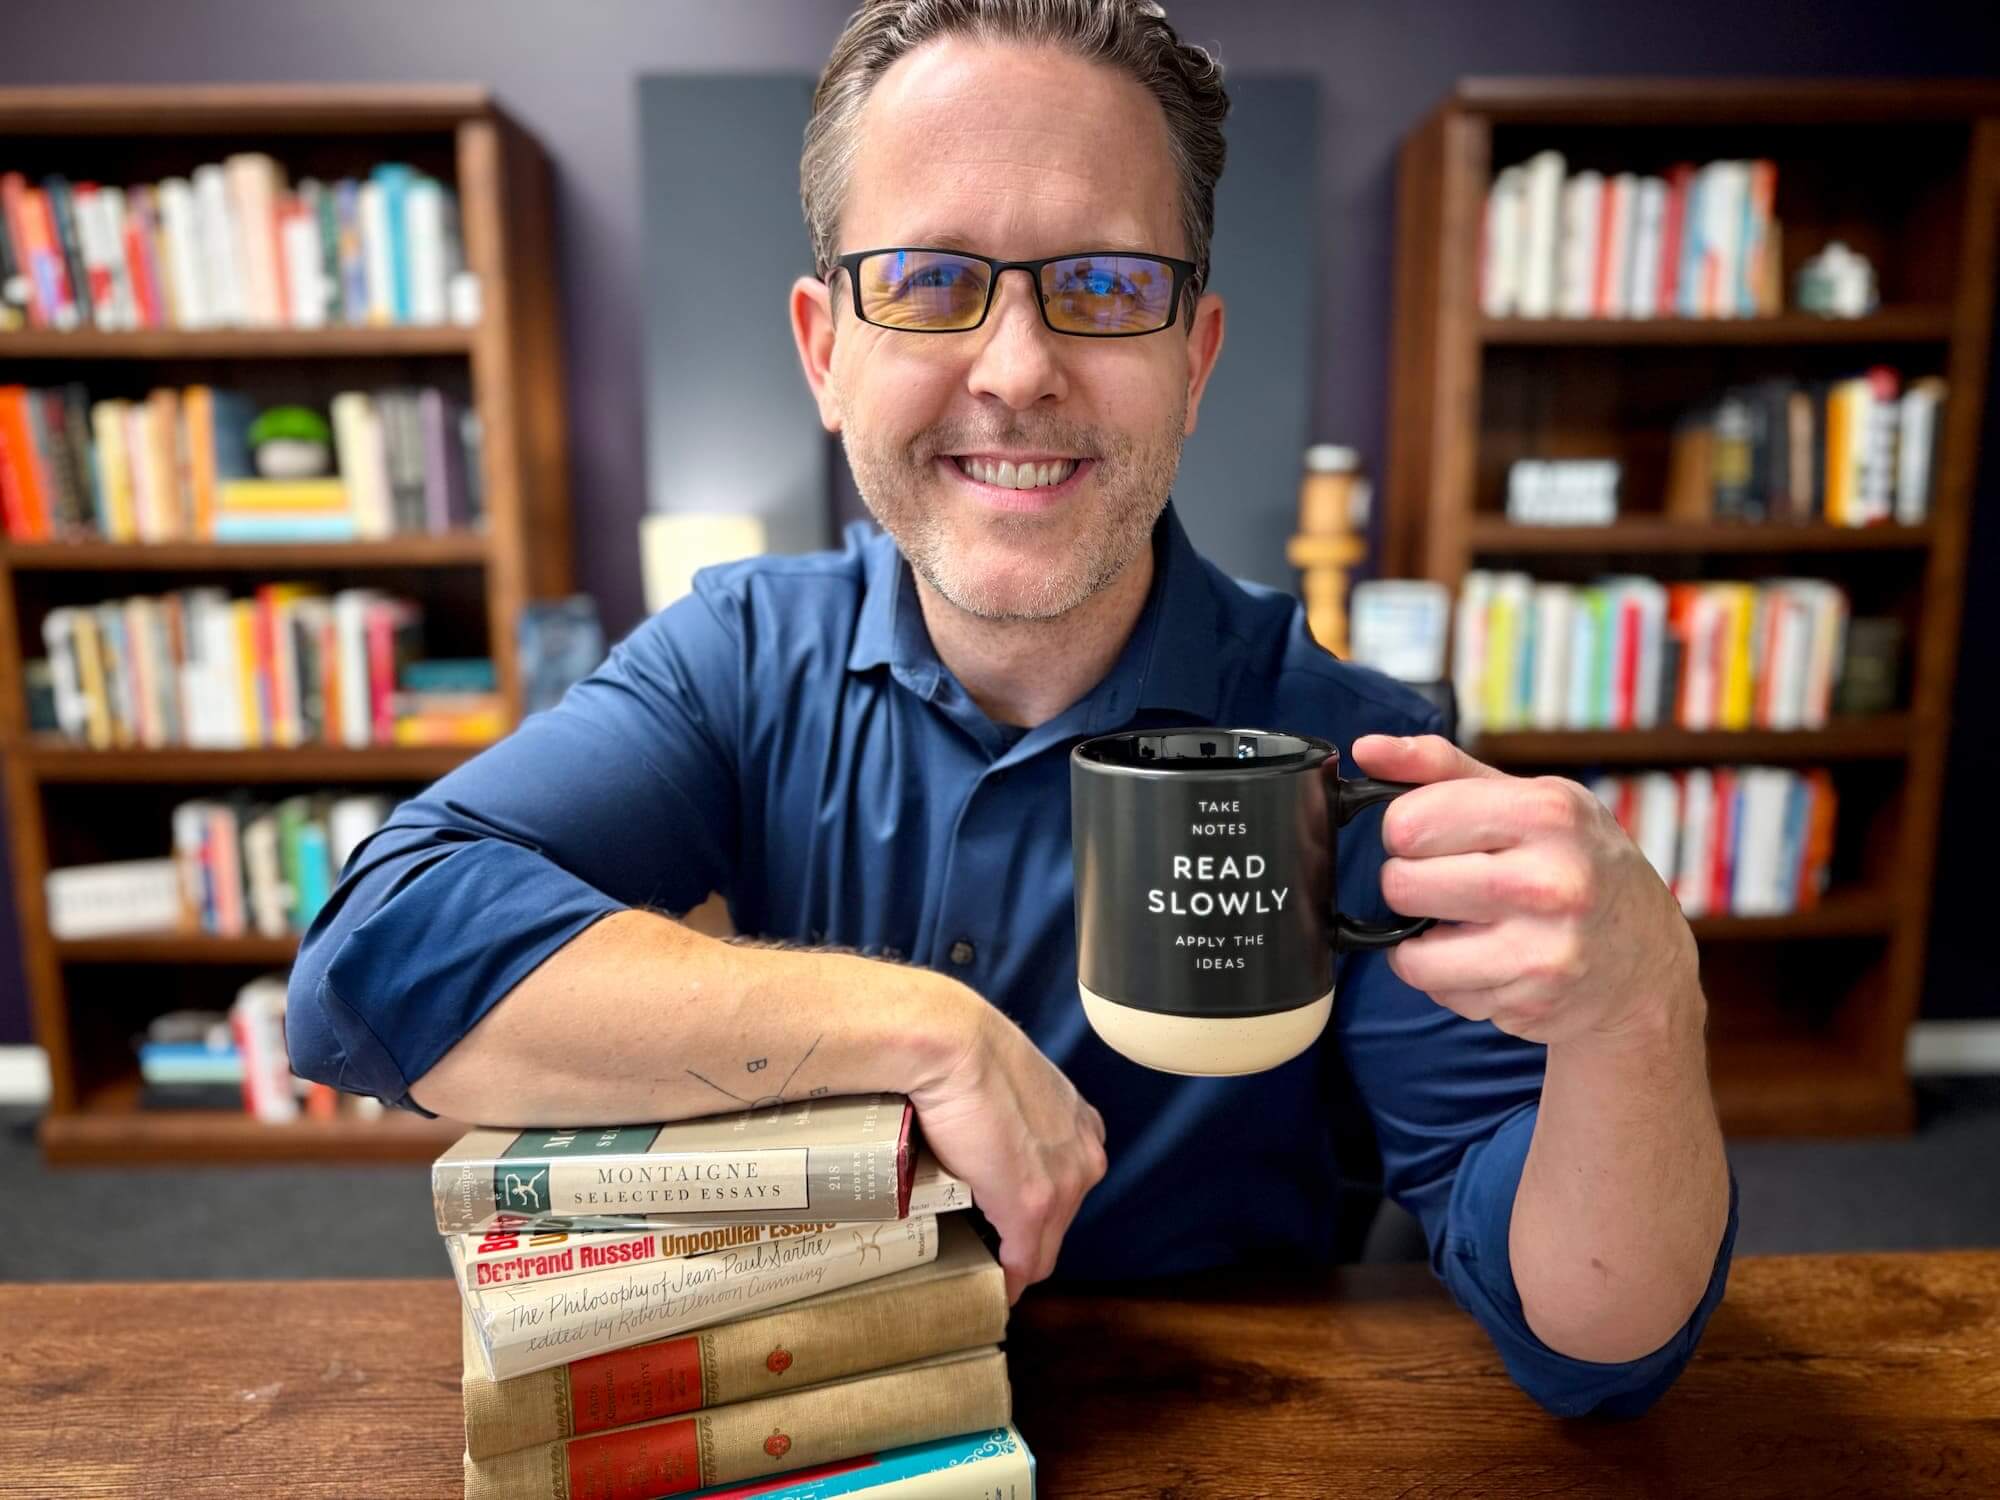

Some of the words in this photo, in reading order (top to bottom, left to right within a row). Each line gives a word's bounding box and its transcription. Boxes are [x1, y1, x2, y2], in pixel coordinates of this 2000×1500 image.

[1199, 801, 1240, 813] TAKE
[1192, 823, 1247, 835] NOTES
[1173, 855, 1266, 880] READ
[1148, 887, 1289, 916] SLOWLY
[1175, 935, 1226, 948] APPLY
[1233, 934, 1264, 946] THE
[1196, 957, 1245, 969] IDEAS
[598, 1162, 759, 1184] MONTAIGNE
[828, 1165, 841, 1191] 218
[853, 1152, 862, 1201] MODERN
[867, 1152, 877, 1200] LIBRARY
[462, 1160, 474, 1220] Montaign
[574, 1188, 690, 1204] SELECTED
[701, 1184, 782, 1200] ESSAYS
[477, 1248, 573, 1286] Bertrand
[580, 1233, 655, 1269] Russell
[661, 1224, 766, 1257] Unpopular
[506, 1304, 544, 1332] The
[546, 1276, 649, 1321] Philosophy
[652, 1271, 671, 1301] of
[673, 1246, 768, 1293] Jean-Paul
[767, 1234, 832, 1270] Sartre
[526, 1321, 590, 1352] edited
[594, 1317, 614, 1341] by
[618, 1299, 677, 1334] Robert
[677, 1284, 743, 1317] Denoon
[748, 1265, 827, 1298] Cumming
